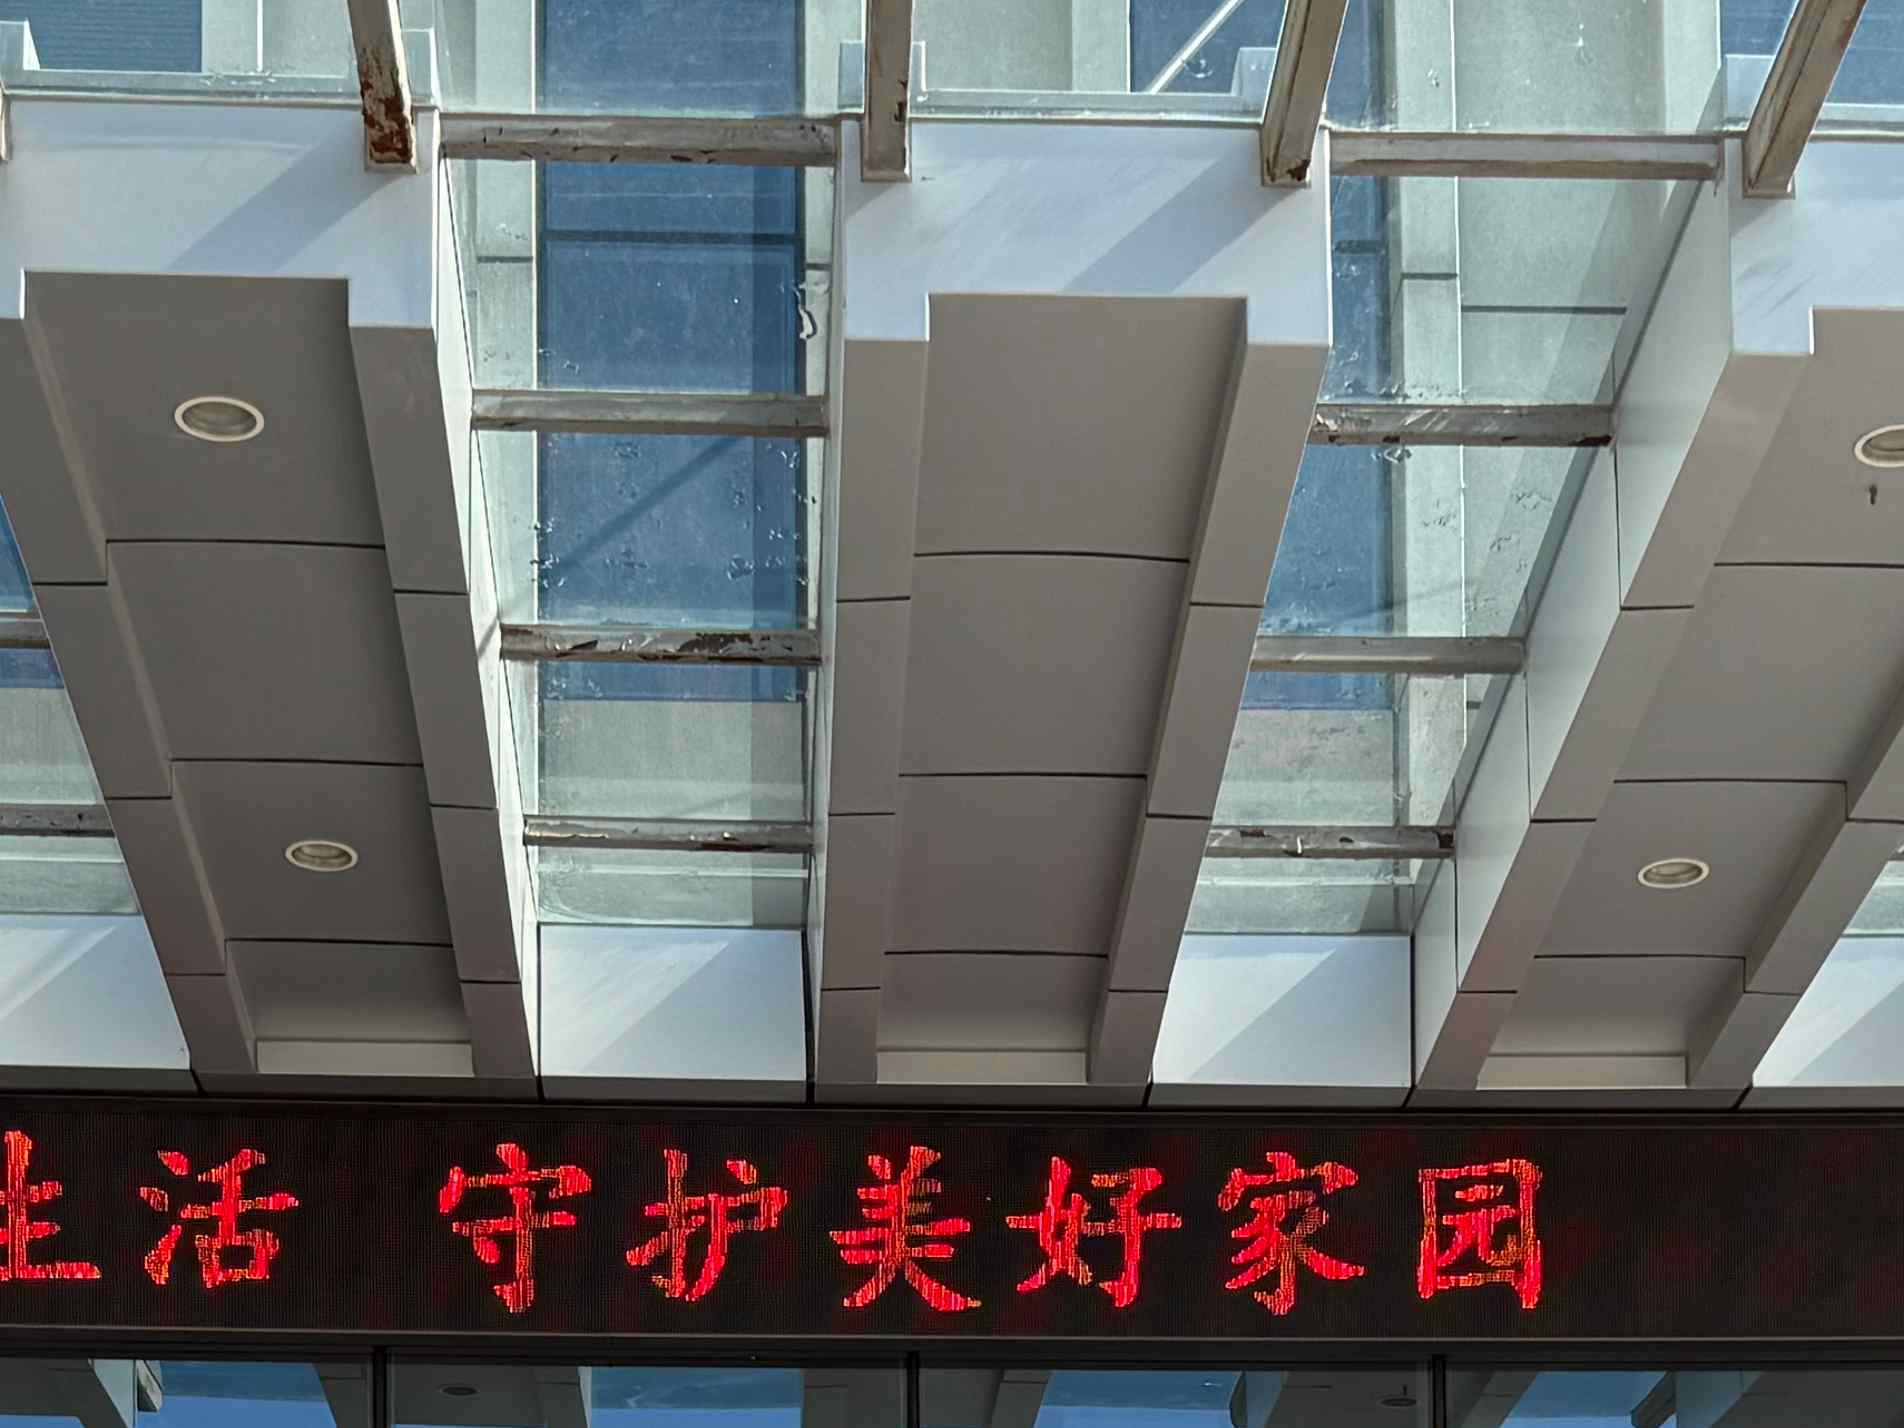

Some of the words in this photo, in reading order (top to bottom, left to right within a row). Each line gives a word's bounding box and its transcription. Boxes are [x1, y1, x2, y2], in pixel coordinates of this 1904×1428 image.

[440, 1143, 1542, 1315] 守护美好家园
